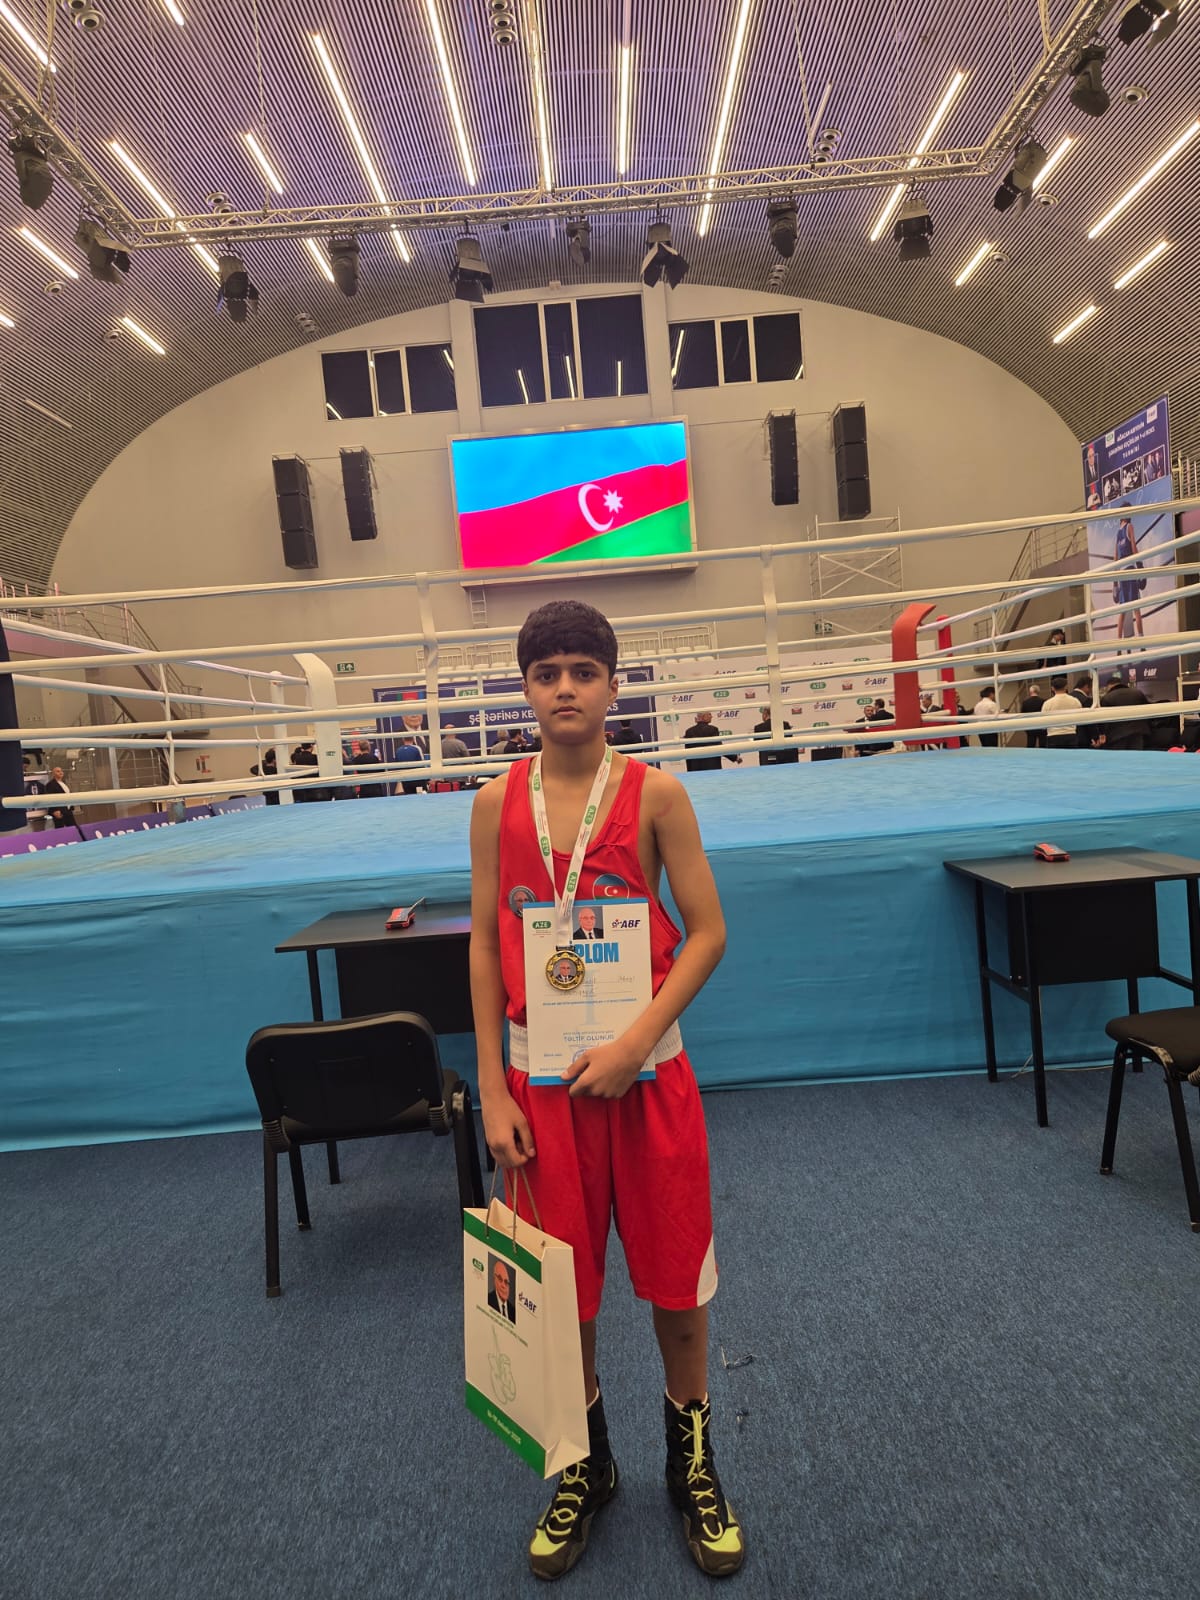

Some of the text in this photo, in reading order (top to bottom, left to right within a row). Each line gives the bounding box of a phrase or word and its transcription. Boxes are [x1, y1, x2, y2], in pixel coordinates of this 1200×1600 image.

[678, 694, 694, 702] ABF
[568, 874, 577, 890] AZE
[621, 920, 640, 928] ABF
[570, 941, 619, 963] PLOM
[524, 1298, 537, 1313] ABF
